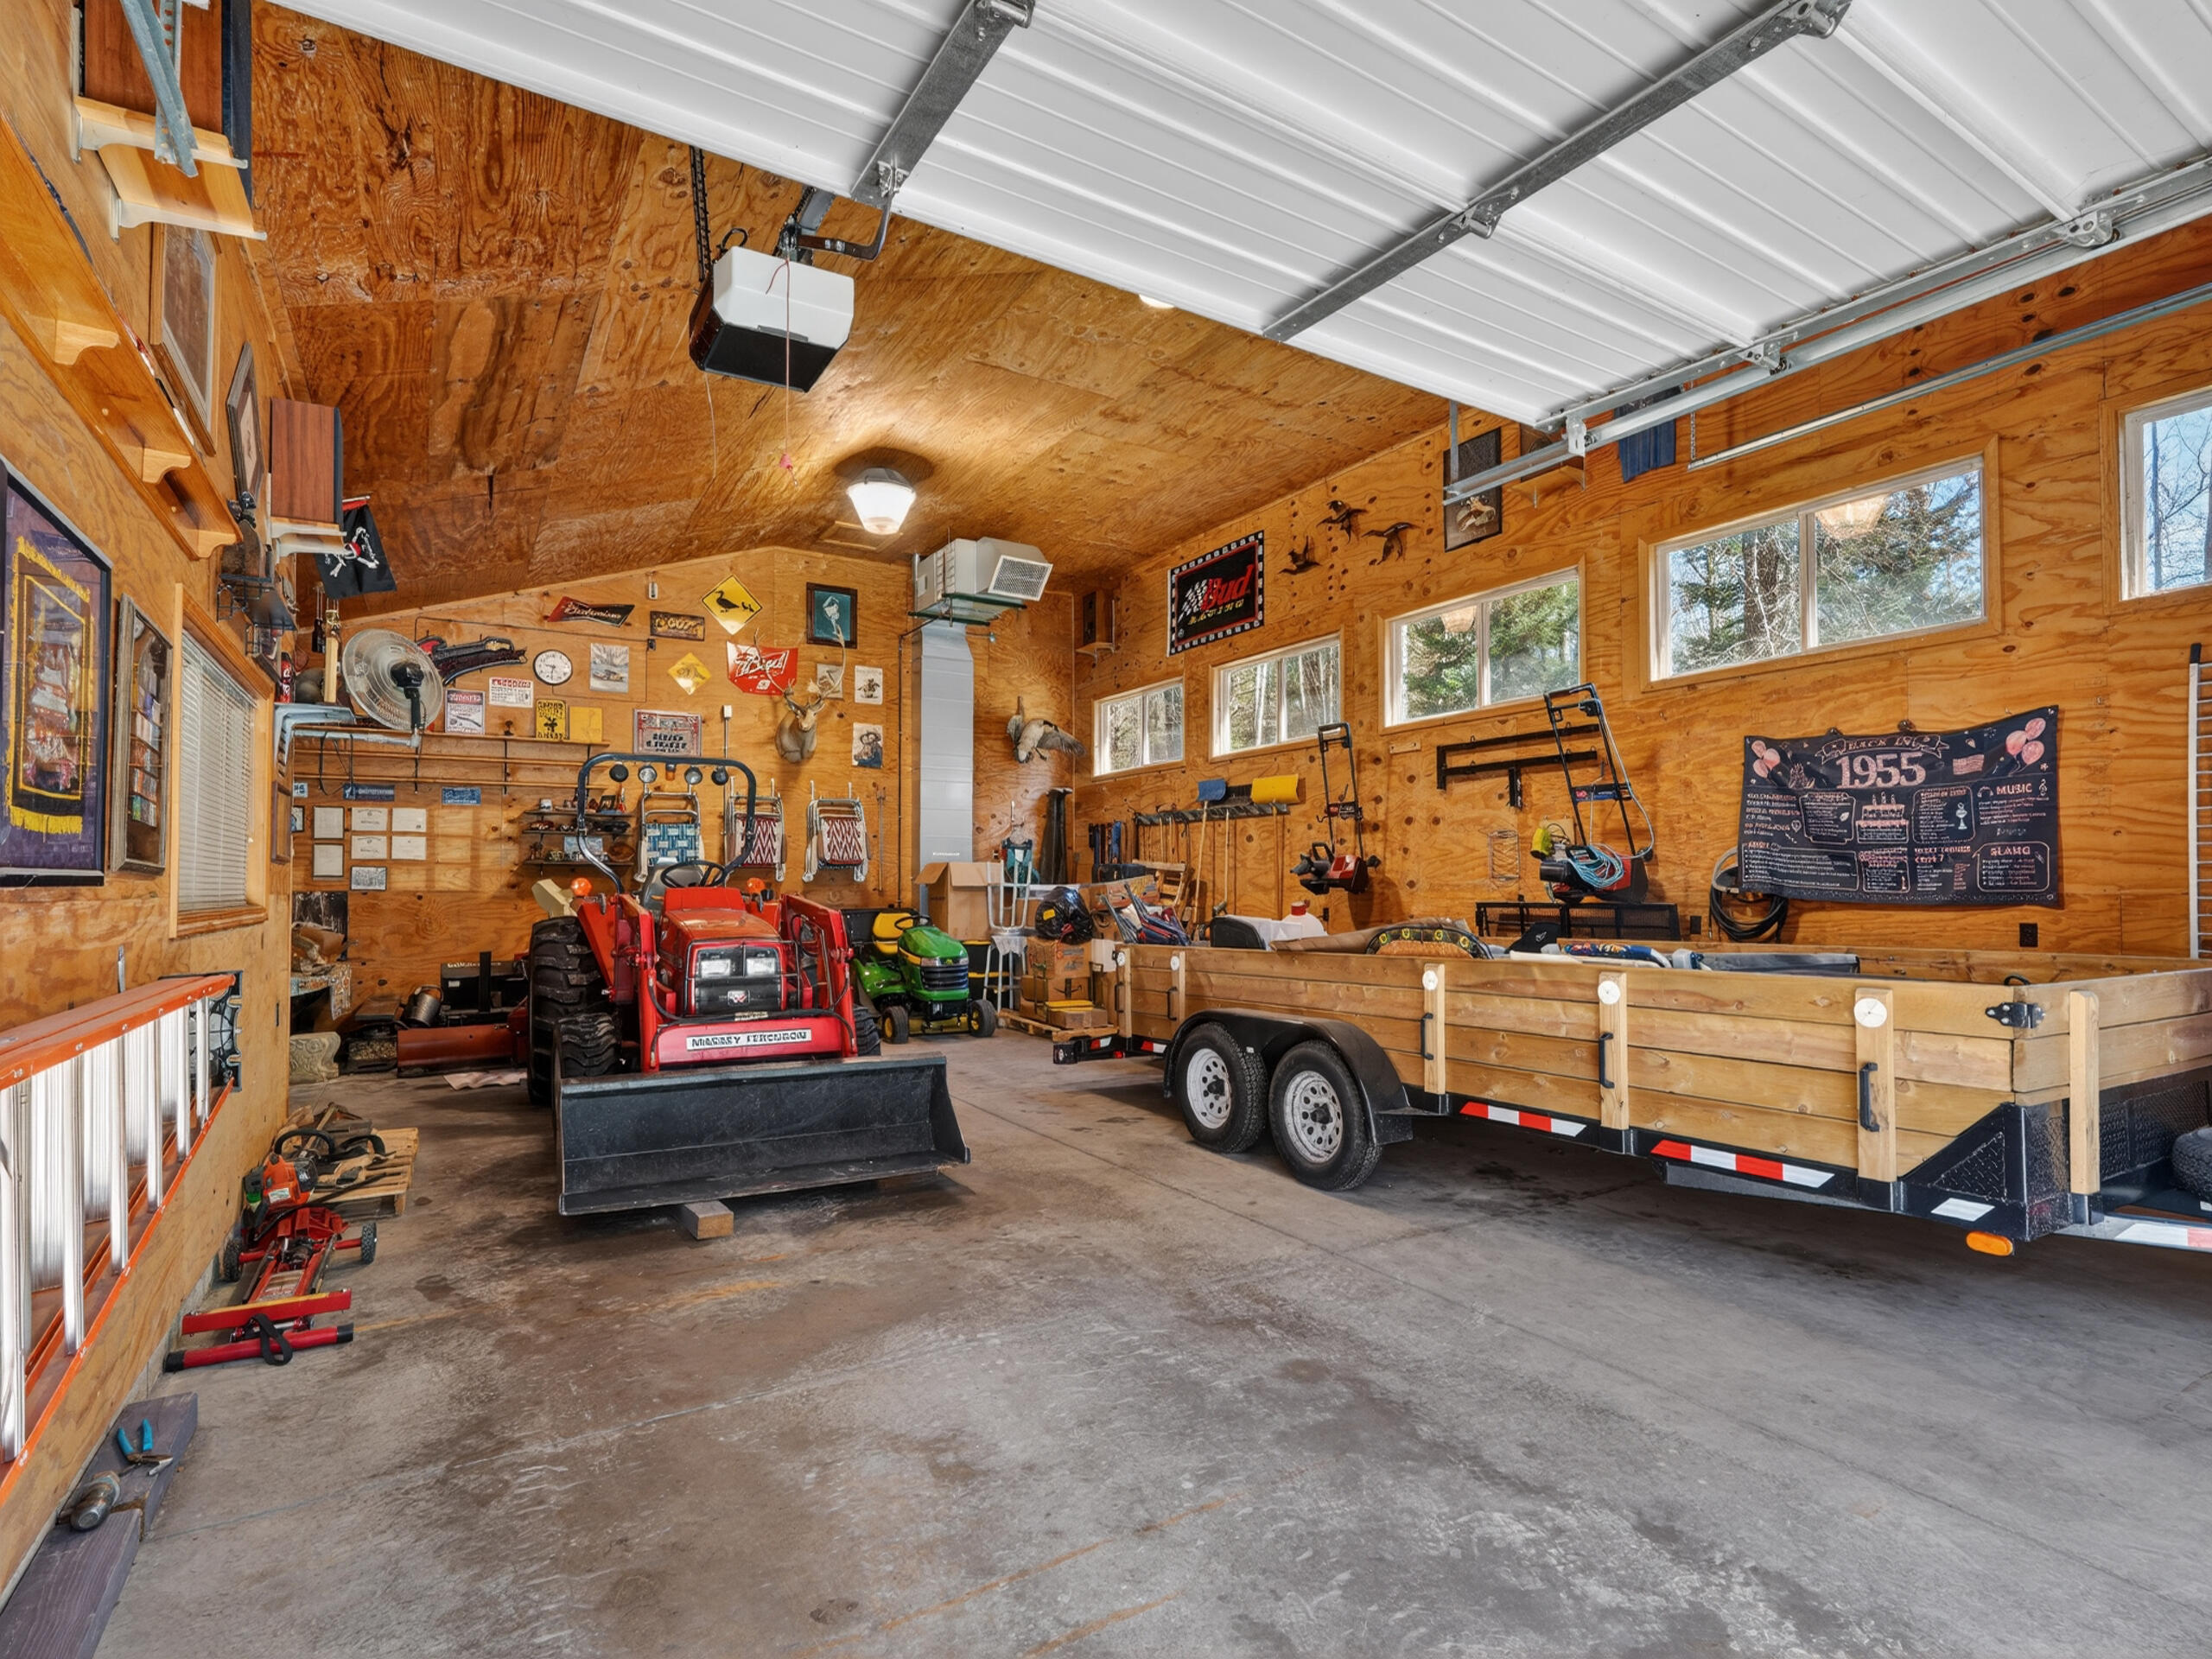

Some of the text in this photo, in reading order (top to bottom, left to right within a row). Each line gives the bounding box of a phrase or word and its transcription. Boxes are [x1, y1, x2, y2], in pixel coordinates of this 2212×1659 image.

[1200, 563, 1255, 612] Bud
[1836, 751, 1926, 789] 1955
[1996, 783, 2032, 795] MUSIC
[691, 1036, 741, 1047] MASSEY
